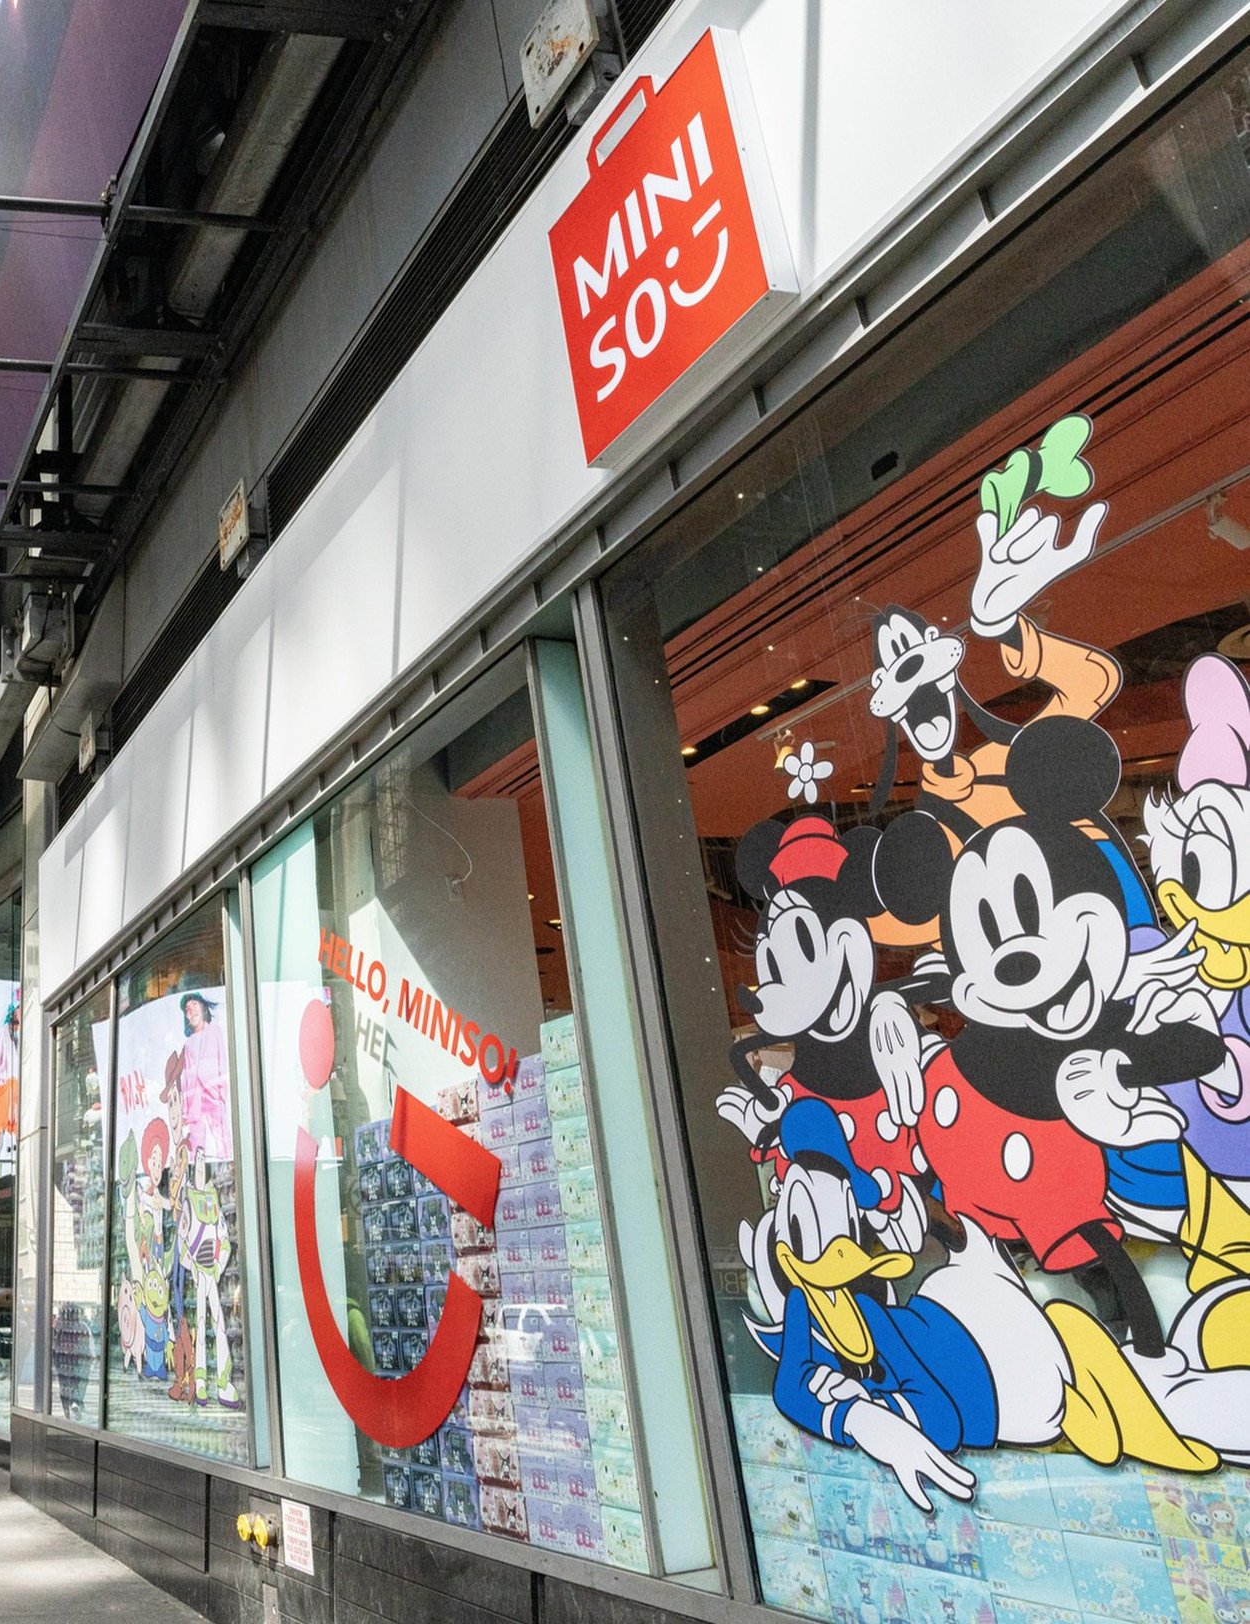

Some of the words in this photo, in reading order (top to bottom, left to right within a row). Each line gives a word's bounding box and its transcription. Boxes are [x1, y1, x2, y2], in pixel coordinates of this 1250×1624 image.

[573, 112, 713, 319] MINI
[318, 927, 390, 1014] HELLO,
[397, 977, 518, 1095] MINISO!
